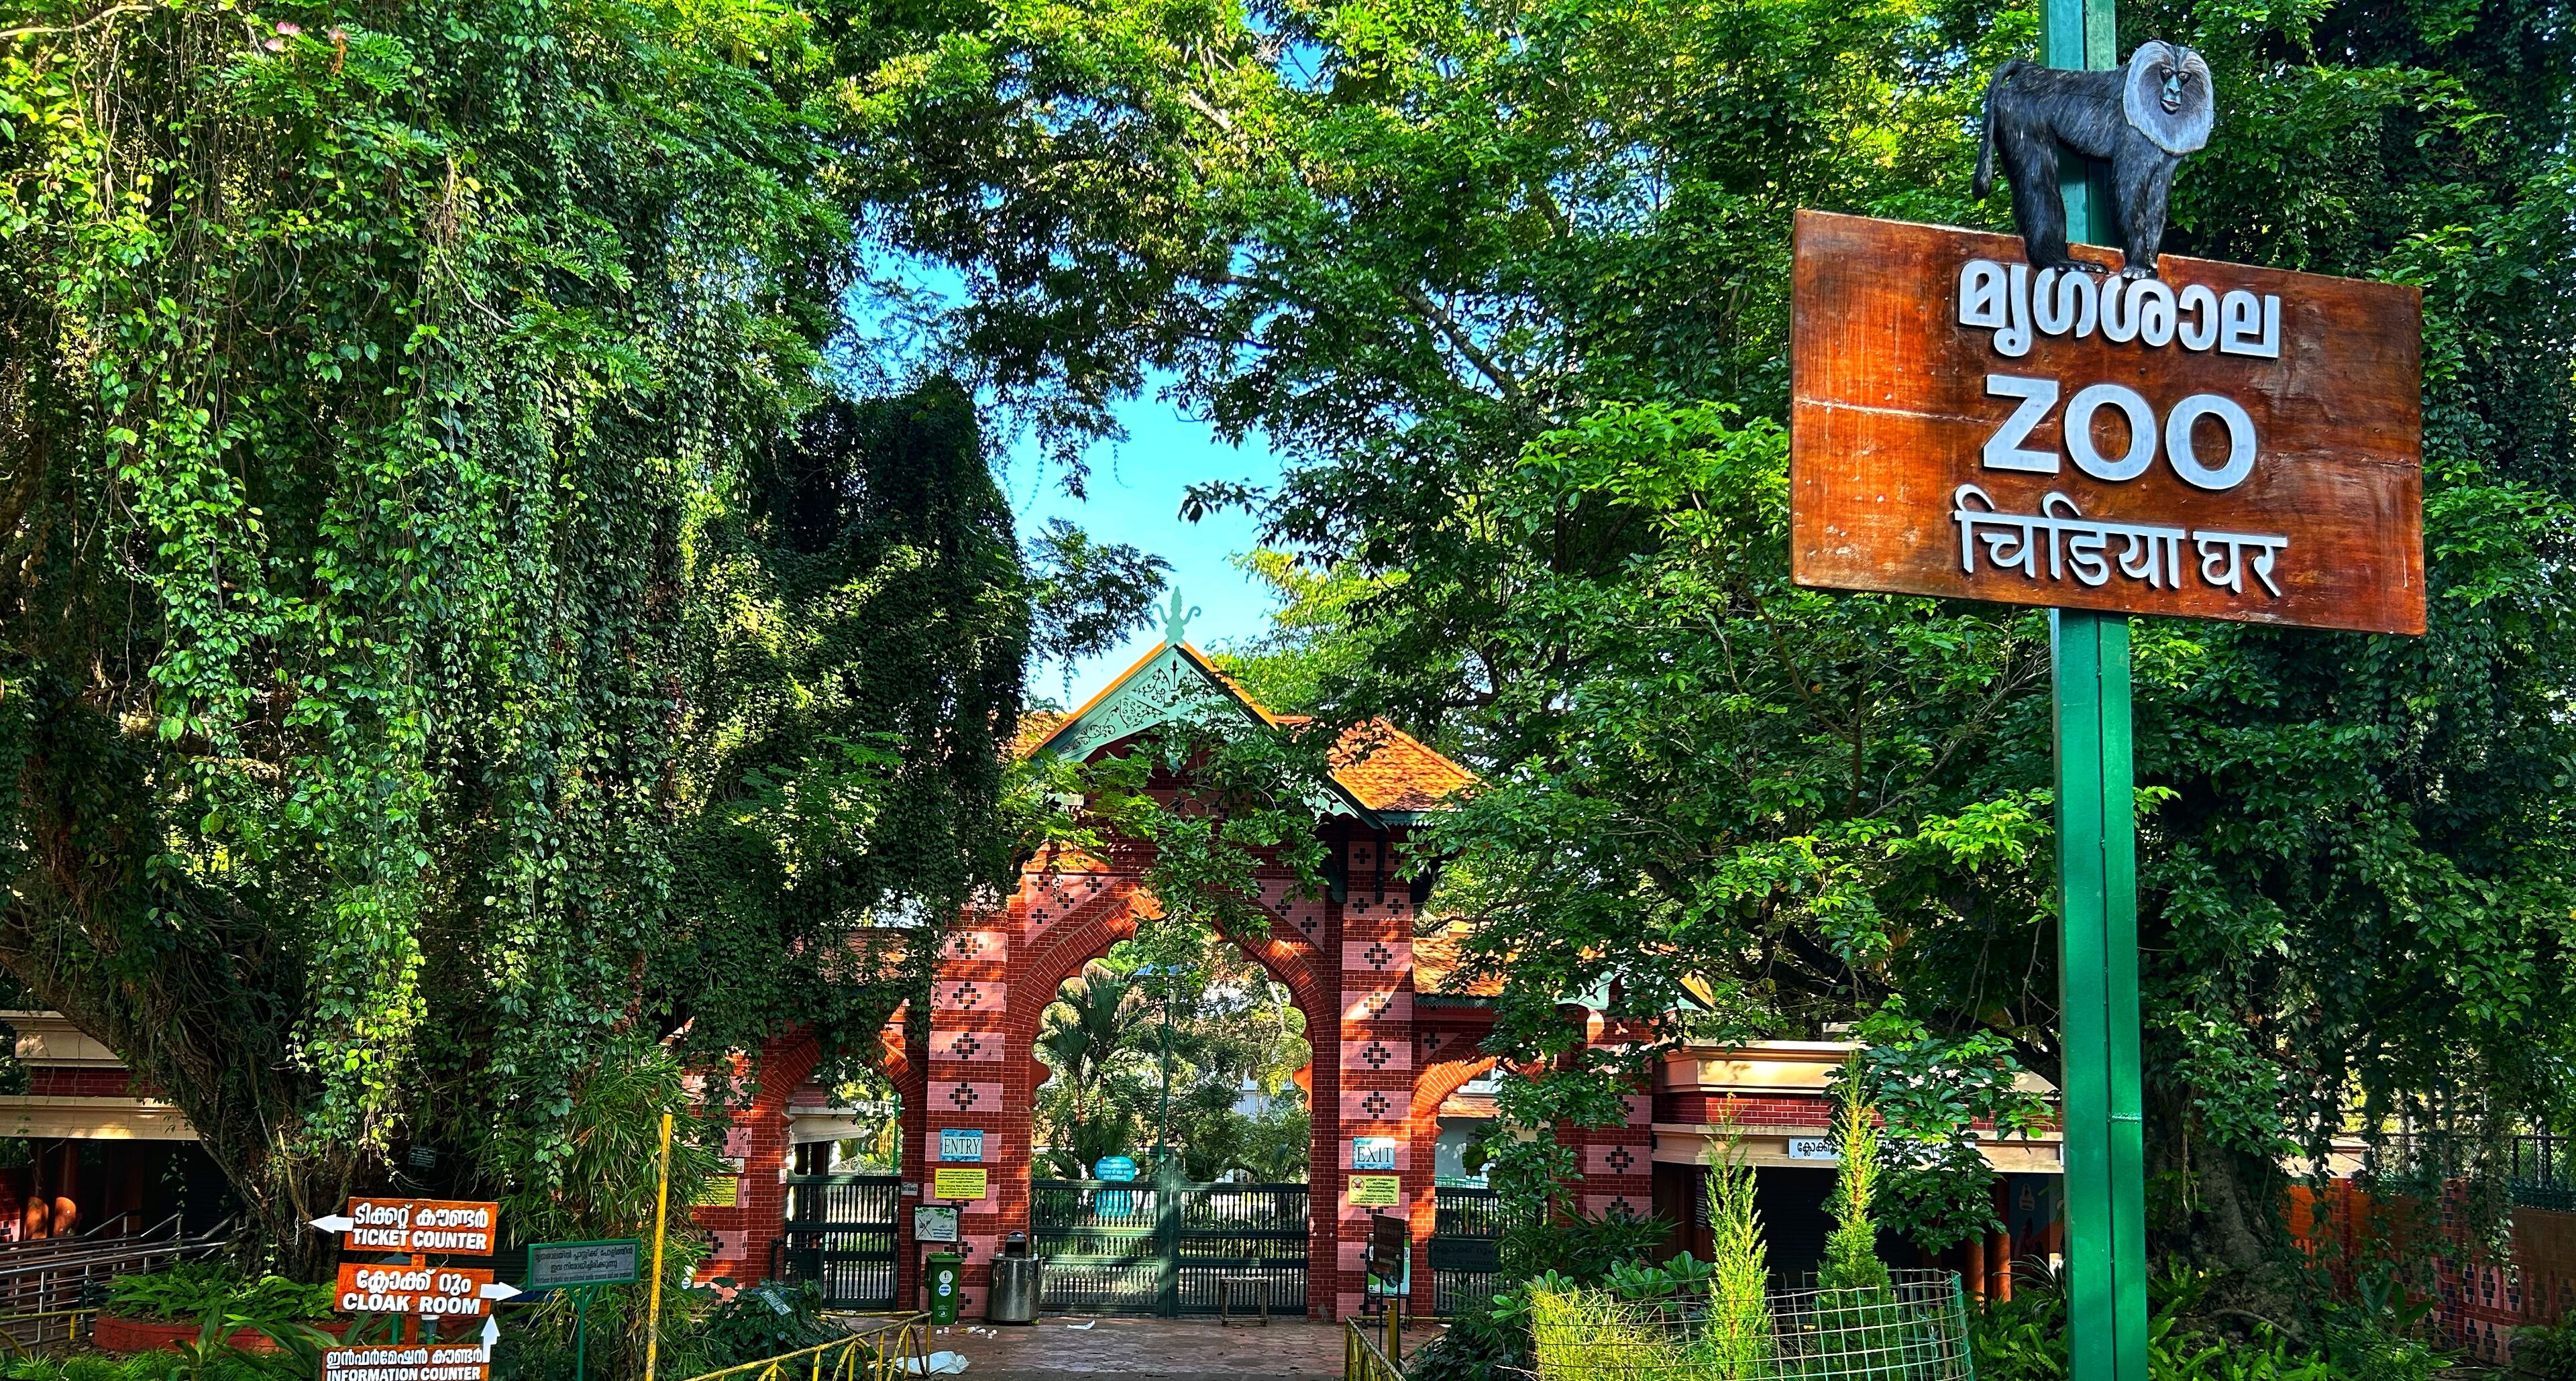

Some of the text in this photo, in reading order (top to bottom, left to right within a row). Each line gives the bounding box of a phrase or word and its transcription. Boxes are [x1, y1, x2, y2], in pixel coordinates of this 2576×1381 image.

[1959, 259, 2280, 357] മൃഗശാല
[1983, 374, 2257, 490] ZOO
[2192, 530, 2288, 597] घर
[944, 1138, 981, 1154] ENTRY
[1356, 1146, 1393, 1162] EXIT
[355, 1202, 488, 1229] ടിക്കറ്റ് കൗണ്ടർ
[353, 1228, 487, 1250] TICKET COUNTER
[356, 1269, 436, 1294] ക്ലോക്ക്
[343, 1292, 480, 1315] CLOAK ROOM
[327, 1347, 483, 1369] ഇൻഫർമേഷൻ കൗണ്ടർ
[327, 1367, 481, 1381] INFORMATION COUNTER
